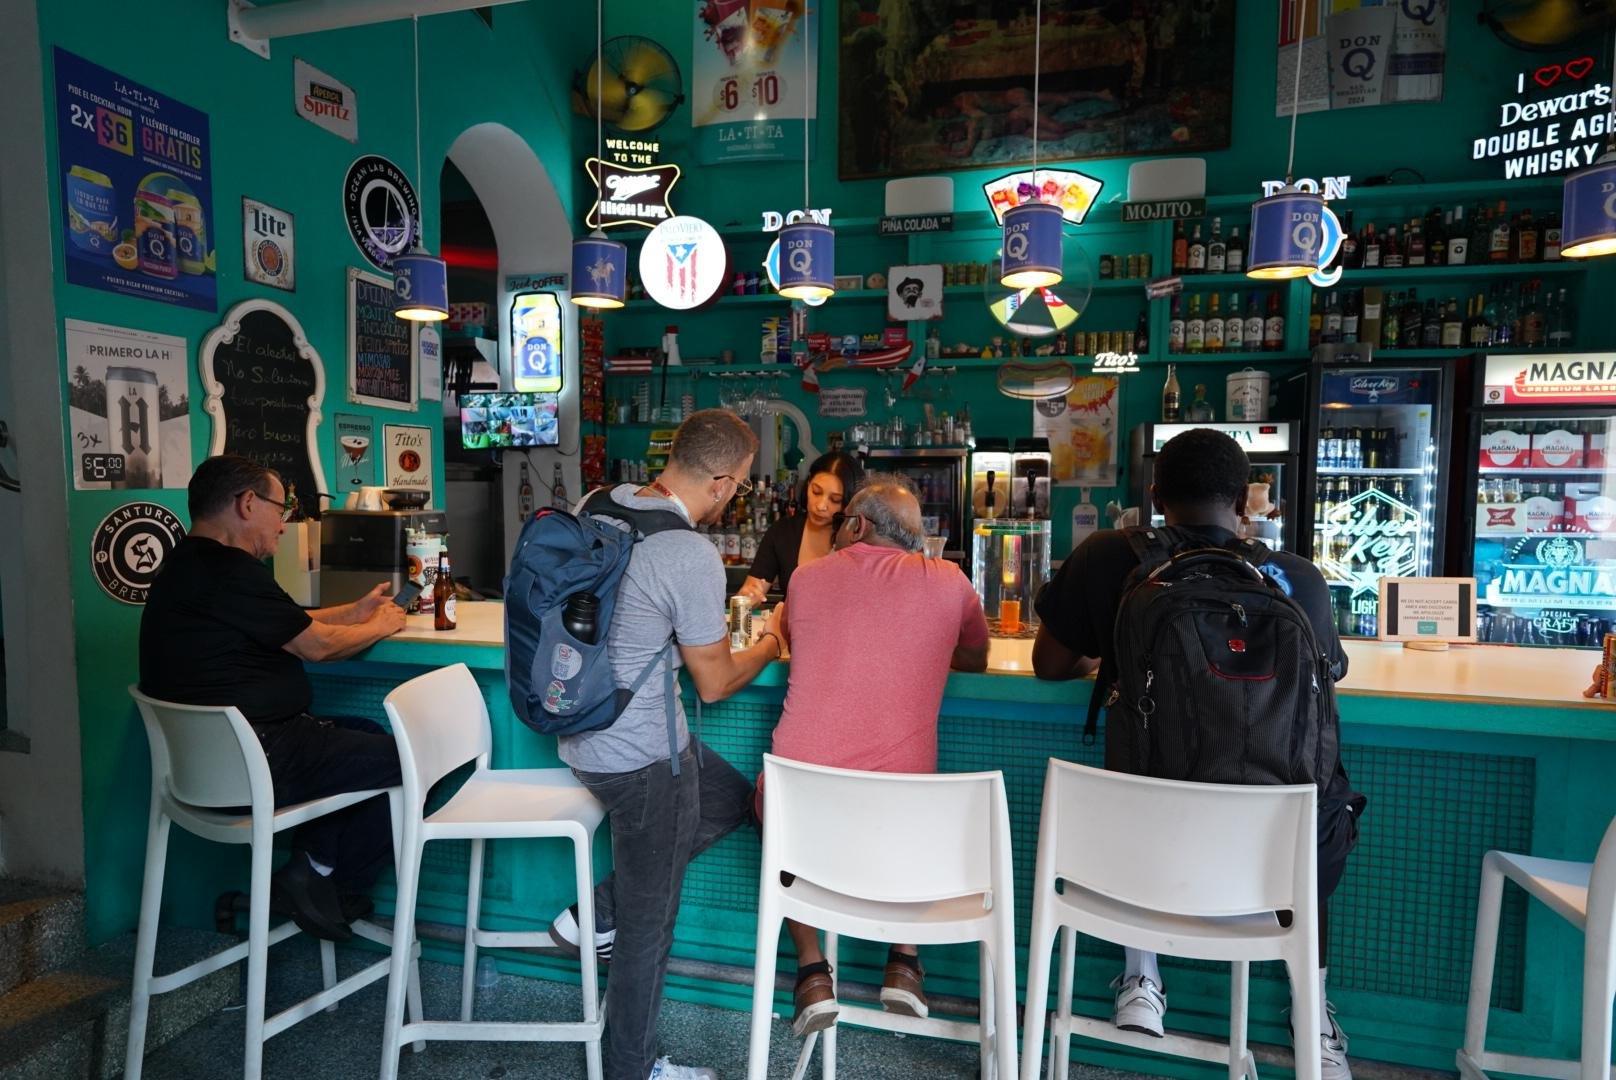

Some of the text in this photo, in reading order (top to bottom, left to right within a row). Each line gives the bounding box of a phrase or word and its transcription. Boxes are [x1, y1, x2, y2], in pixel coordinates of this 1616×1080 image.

[1340, 35, 1380, 48] DON
[1341, 48, 1376, 81] Q
[83, 89, 90, 101] EL
[752, 75, 778, 106] $10
[304, 95, 349, 120] Spritz
[170, 124, 178, 136] UN
[180, 130, 201, 145] COOLER
[1472, 122, 1561, 160] DOUBLE
[142, 126, 201, 169] GRATIS
[606, 139, 659, 153] WELCOME
[614, 153, 652, 164] TO THE
[1505, 142, 1599, 180] WHISKY
[600, 201, 636, 216] HIGH
[1126, 201, 1192, 220] MOJITO
[1291, 212, 1319, 222] DON
[254, 208, 286, 237] Lite
[904, 217, 939, 231] COLADA
[1006, 222, 1030, 236] DON
[788, 240, 813, 249] DON
[1006, 233, 1030, 261] Q
[1292, 222, 1317, 254] Q
[789, 249, 813, 276] Q
[395, 276, 412, 300] Q
[532, 275, 564, 290] COFFEE
[89, 345, 170, 360] PRIMERO LA H
[527, 343, 547, 351] DON
[528, 351, 547, 373] Q
[1094, 352, 1138, 367] Tito's
[128, 386, 137, 397] LA
[338, 423, 371, 432] ESPRESSO
[395, 432, 423, 447] Tito's
[105, 505, 180, 534] SANTURCE
[1323, 504, 1420, 537] Silver
[1340, 534, 1413, 572] Key
[1502, 570, 1616, 596] MAGNA
[1541, 610, 1572, 618] SPECIAL
[1533, 618, 1580, 636] CRAFT
